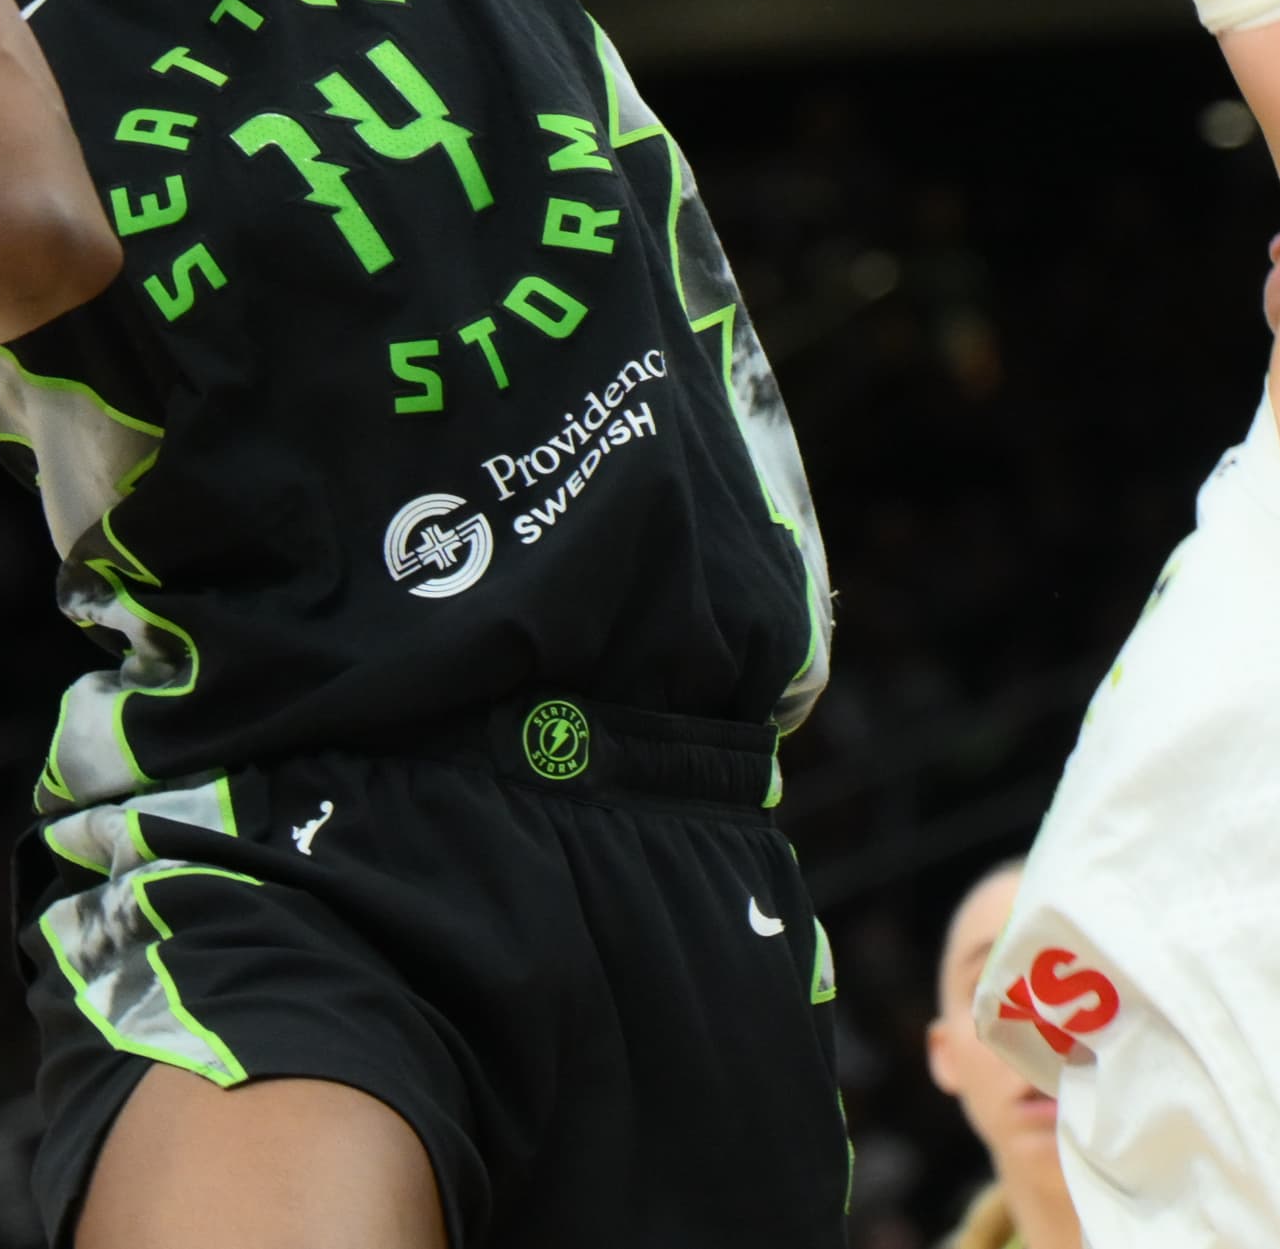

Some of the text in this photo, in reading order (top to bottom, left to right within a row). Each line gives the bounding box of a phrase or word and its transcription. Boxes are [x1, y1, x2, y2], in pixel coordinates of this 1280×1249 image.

[389, 113, 620, 414] STORM
[481, 349, 668, 502] Providenc
[513, 402, 657, 544] SWEDISH
[532, 750, 578, 773] STORM
